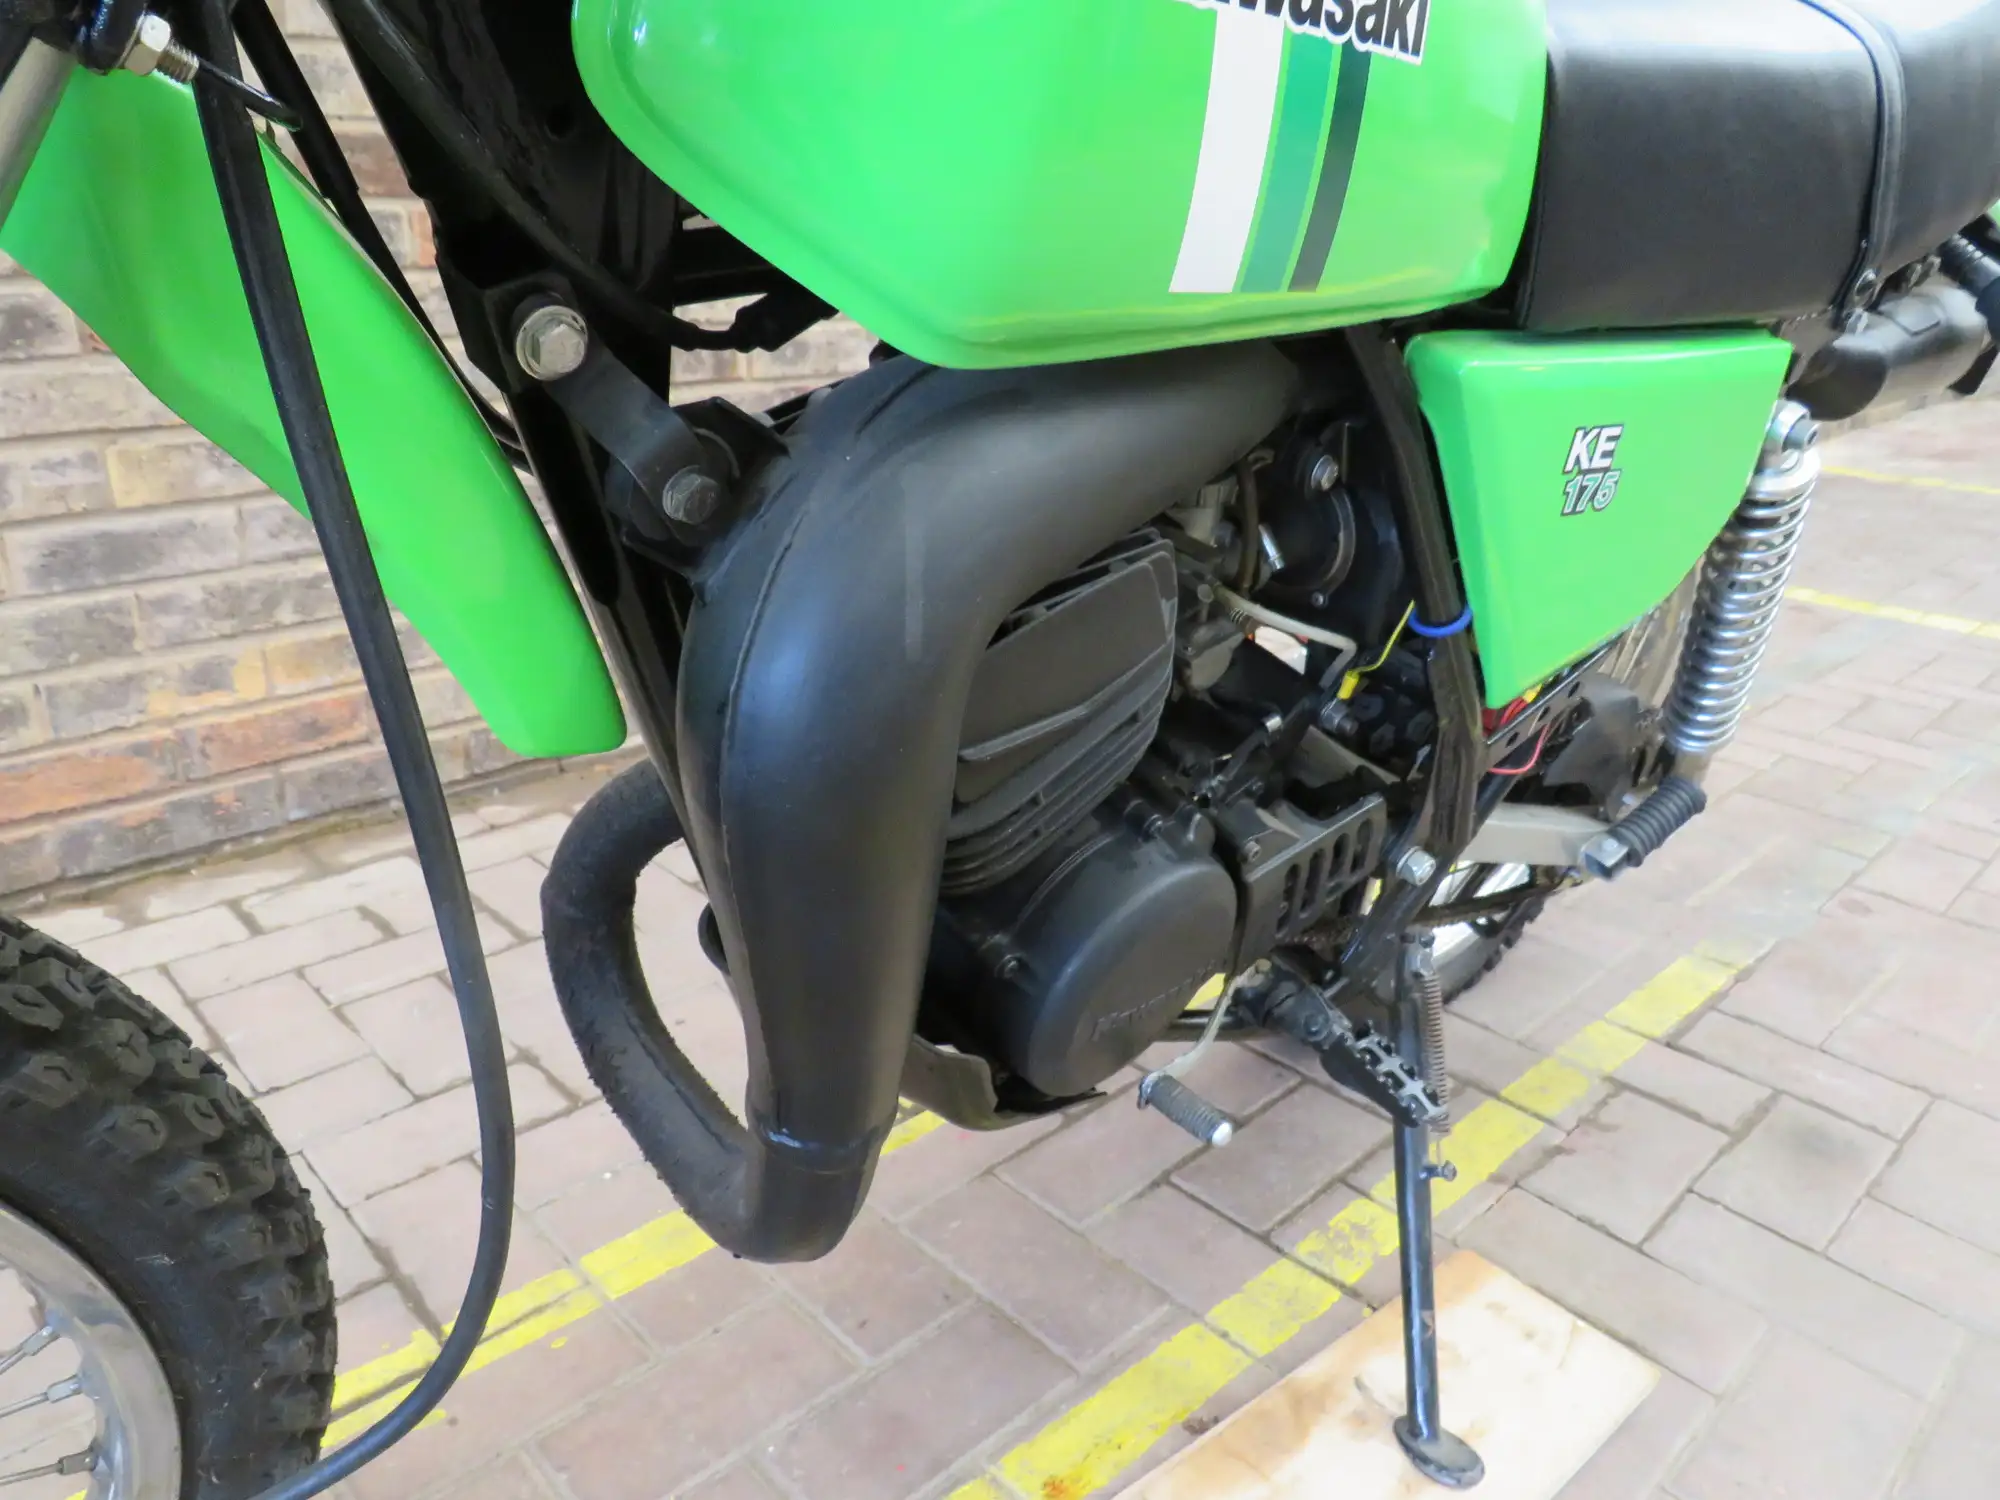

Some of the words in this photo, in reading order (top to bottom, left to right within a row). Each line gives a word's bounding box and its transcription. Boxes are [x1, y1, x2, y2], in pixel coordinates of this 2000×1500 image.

[1196, 0, 1428, 60] asaki
[1563, 424, 1623, 474] KE
[1561, 469, 1621, 515] 175
